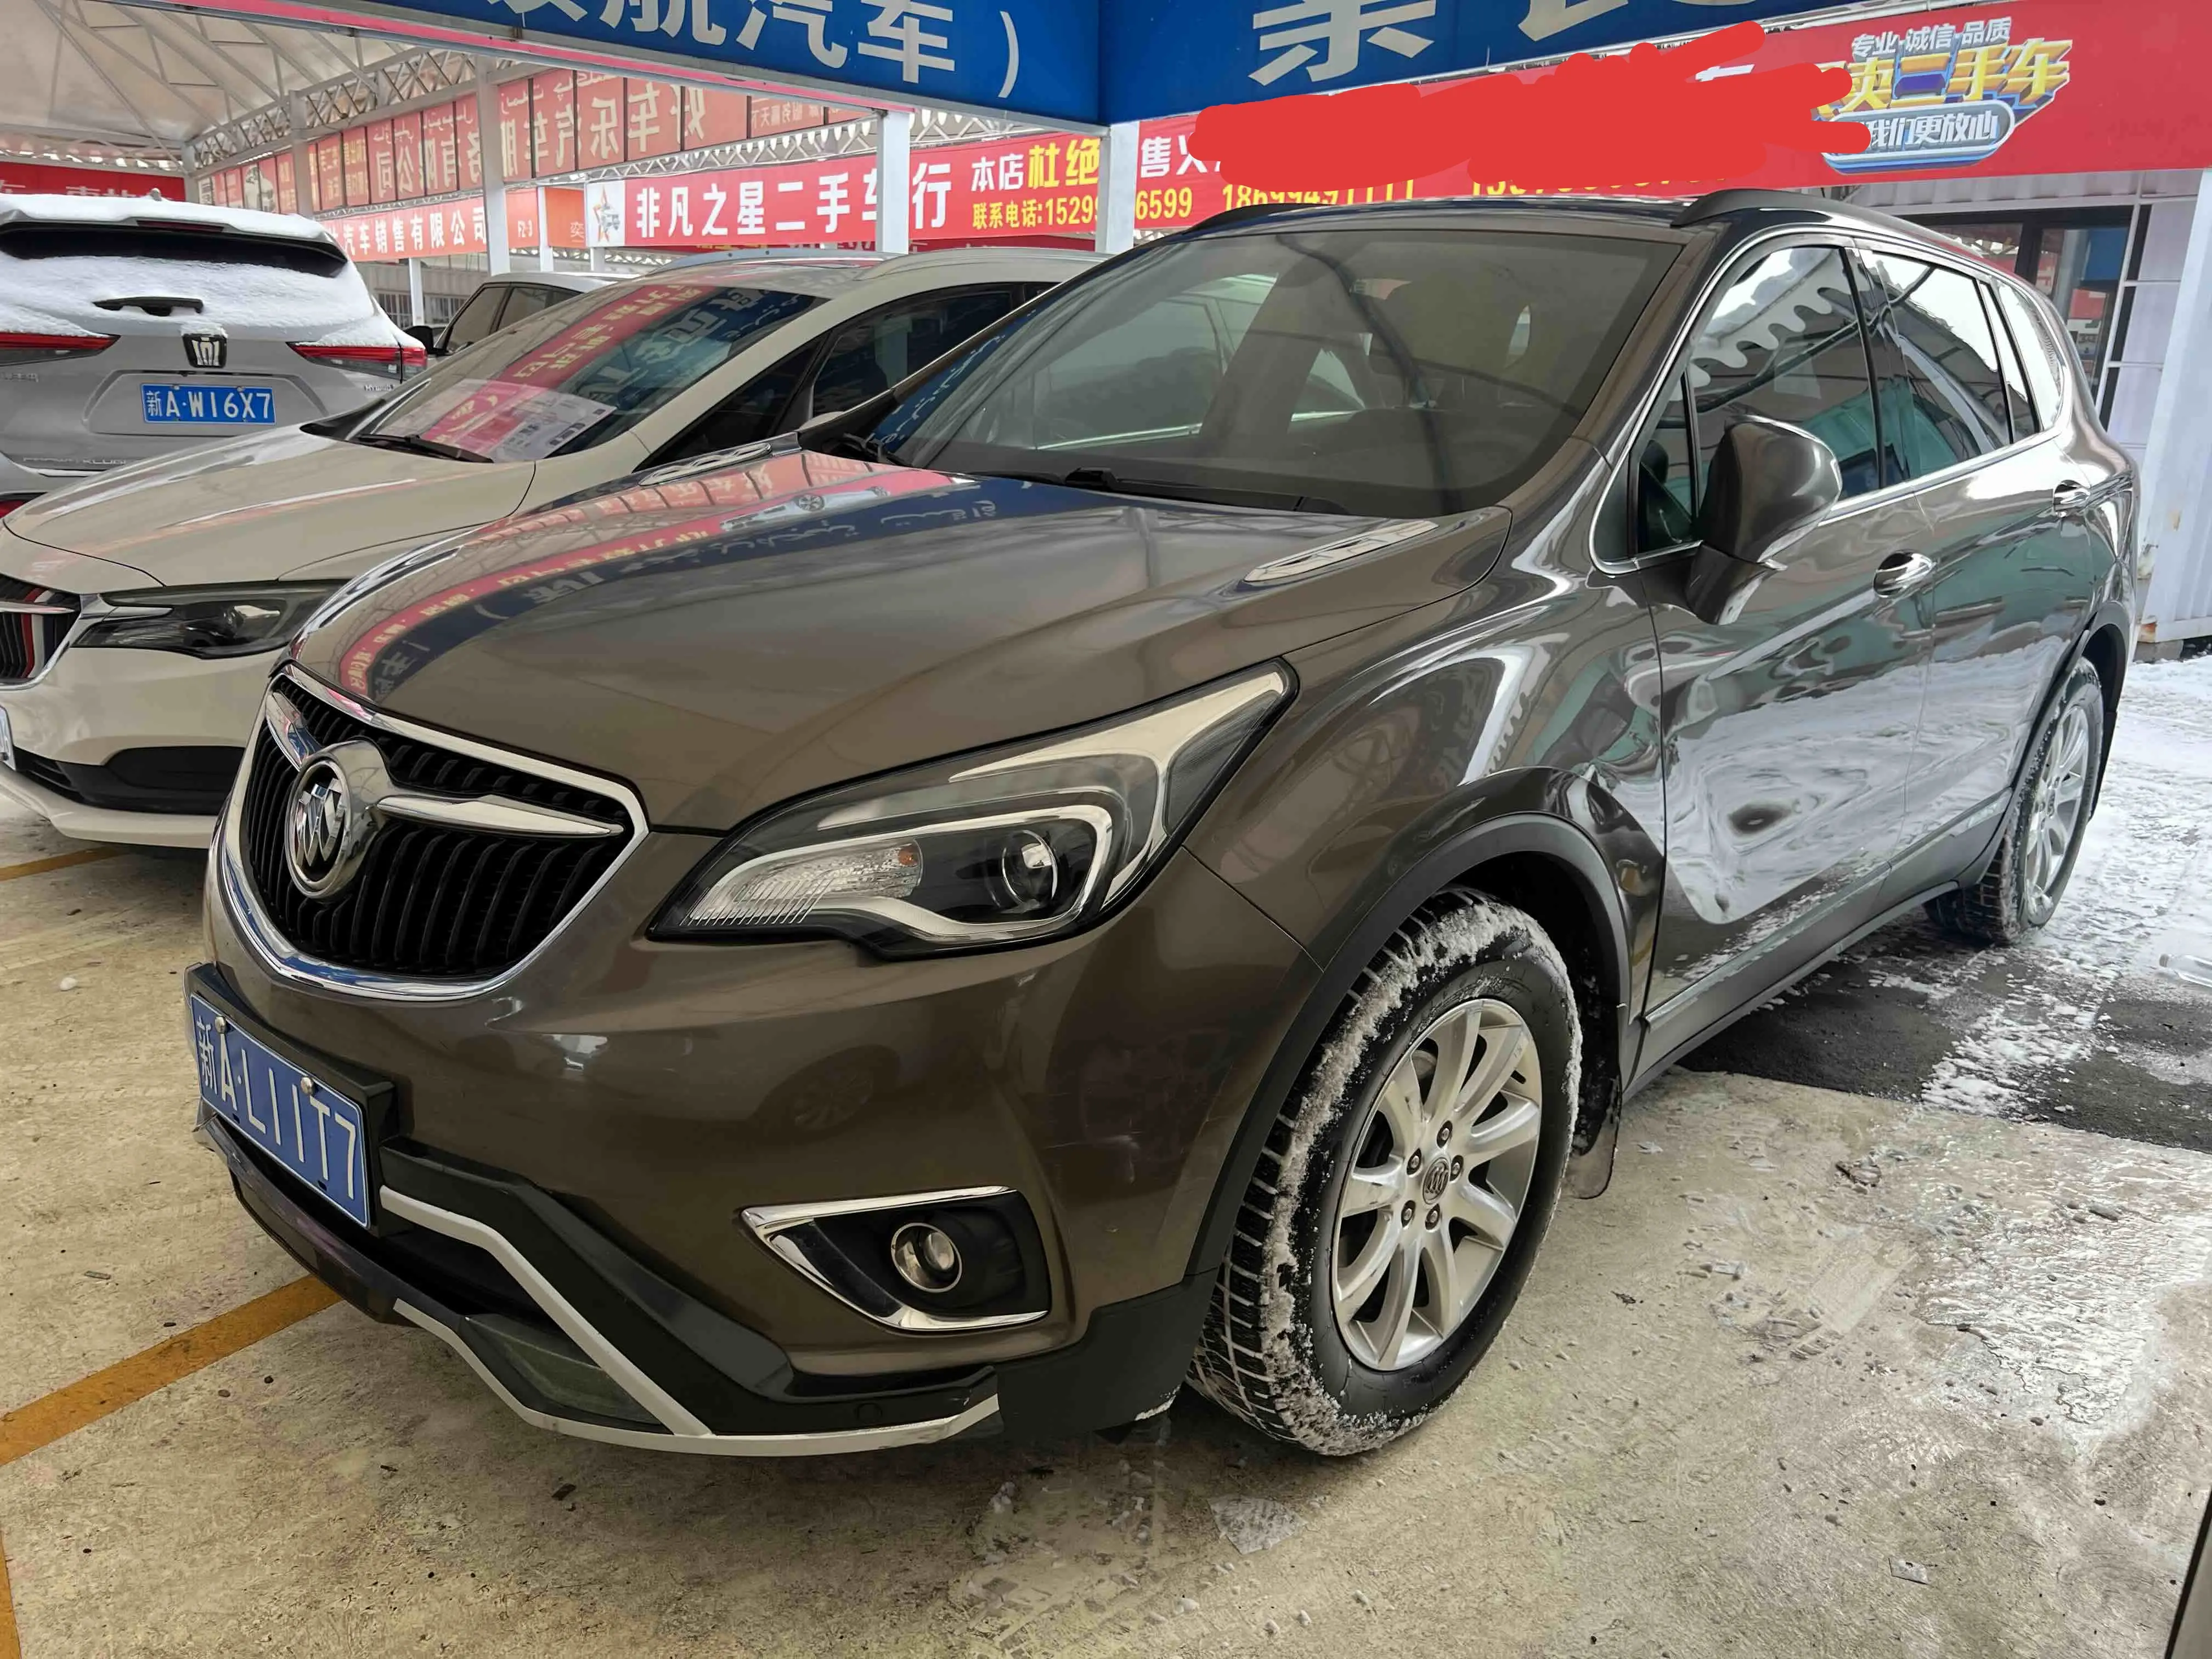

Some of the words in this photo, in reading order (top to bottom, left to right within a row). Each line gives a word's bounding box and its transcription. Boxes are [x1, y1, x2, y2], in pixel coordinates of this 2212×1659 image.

[329, 207, 487, 256] 汽车销售有限公司
